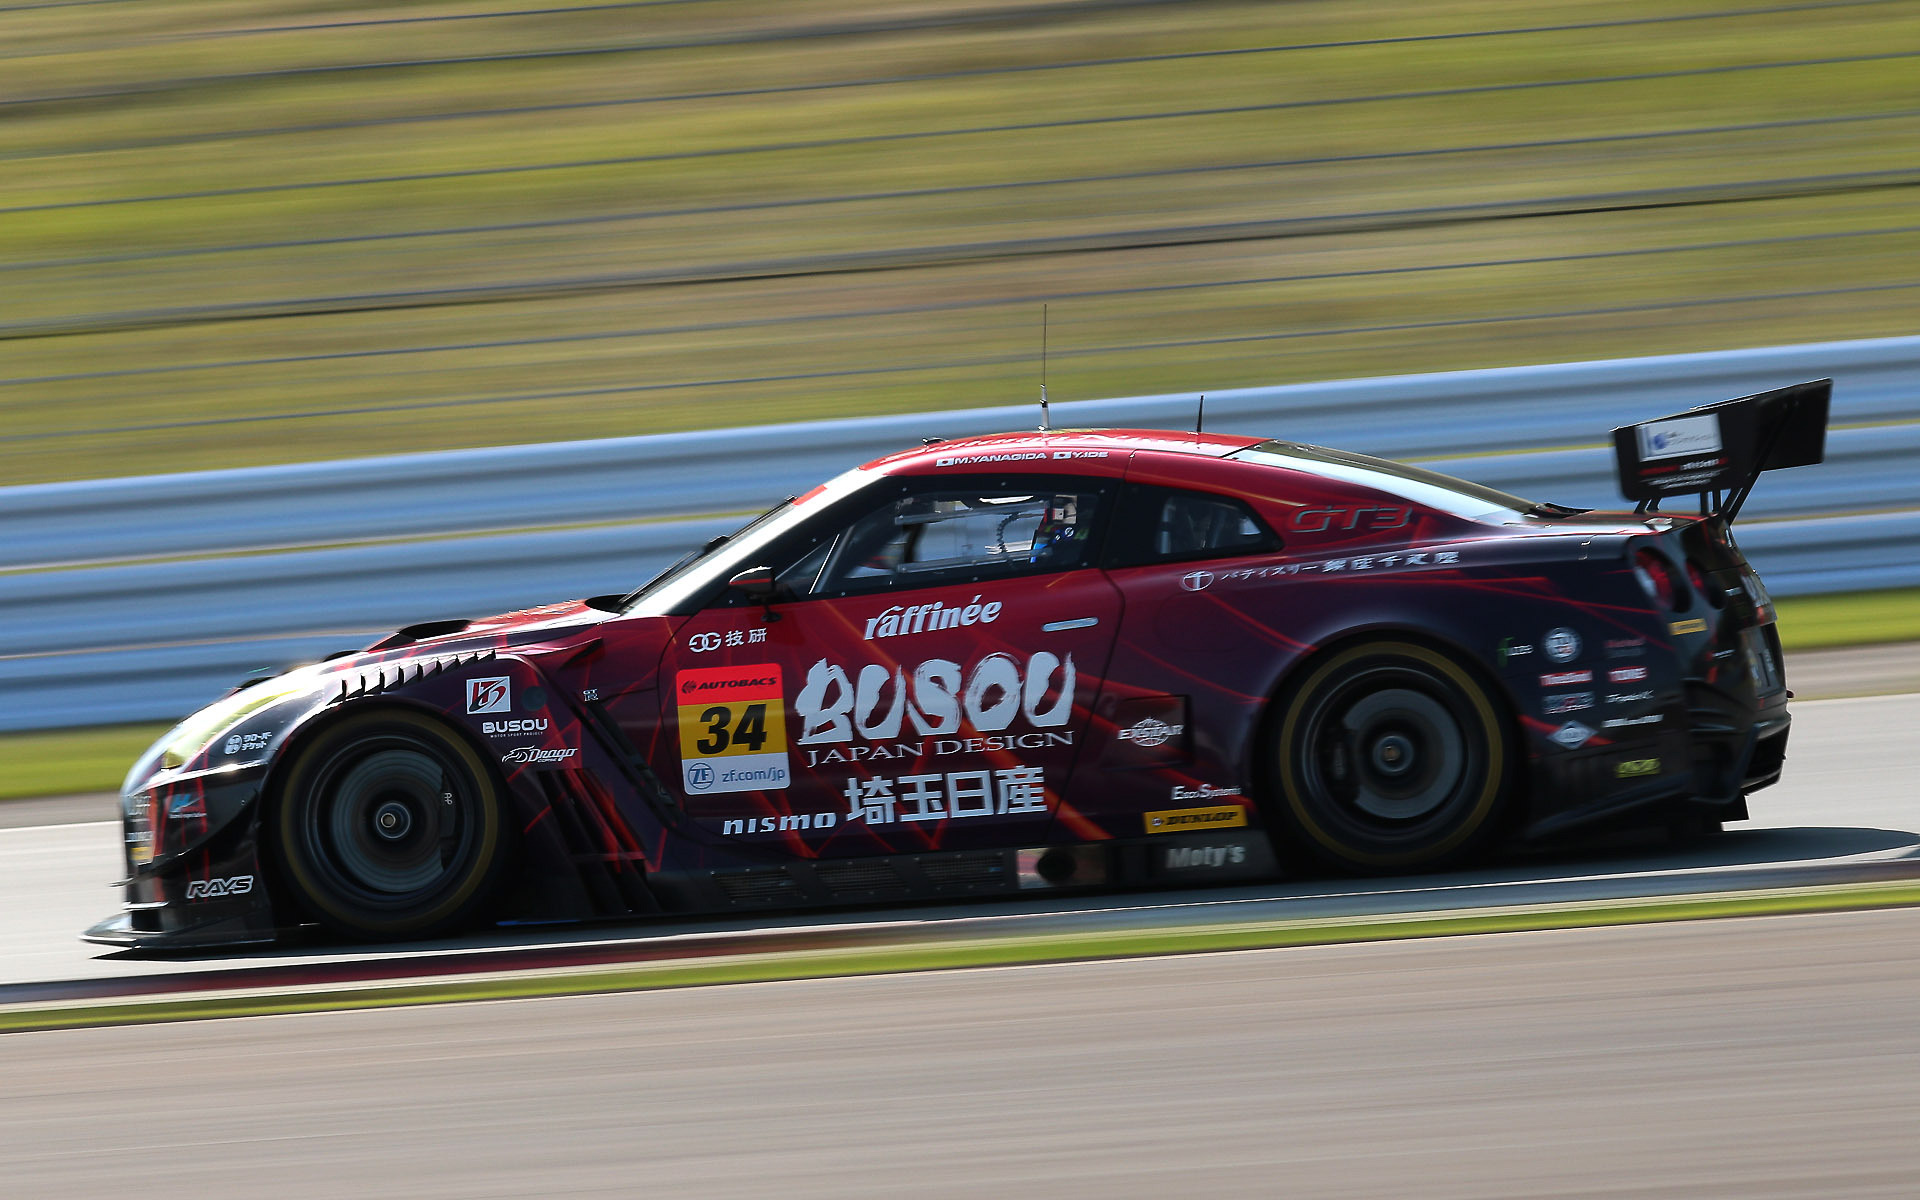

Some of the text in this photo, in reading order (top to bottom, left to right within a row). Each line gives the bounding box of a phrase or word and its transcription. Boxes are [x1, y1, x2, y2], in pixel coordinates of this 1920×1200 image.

[954, 452, 1048, 465] M.YANAGIDA
[1288, 504, 1413, 533] GT3
[862, 594, 1003, 641] raffinée
[698, 676, 777, 690] AUTOBACS
[794, 651, 1077, 746] BUSOU
[482, 718, 548, 734] BUSOU
[696, 703, 767, 755] 34
[527, 747, 579, 763] Drago
[807, 730, 1075, 768] JAPAN DESIGN
[692, 766, 786, 785] ZF zf.com/jp
[844, 765, 1048, 826] 埼玉日産
[723, 812, 837, 836] nismo
[1166, 844, 1245, 869] Moty's
[186, 875, 254, 899] RAYS
